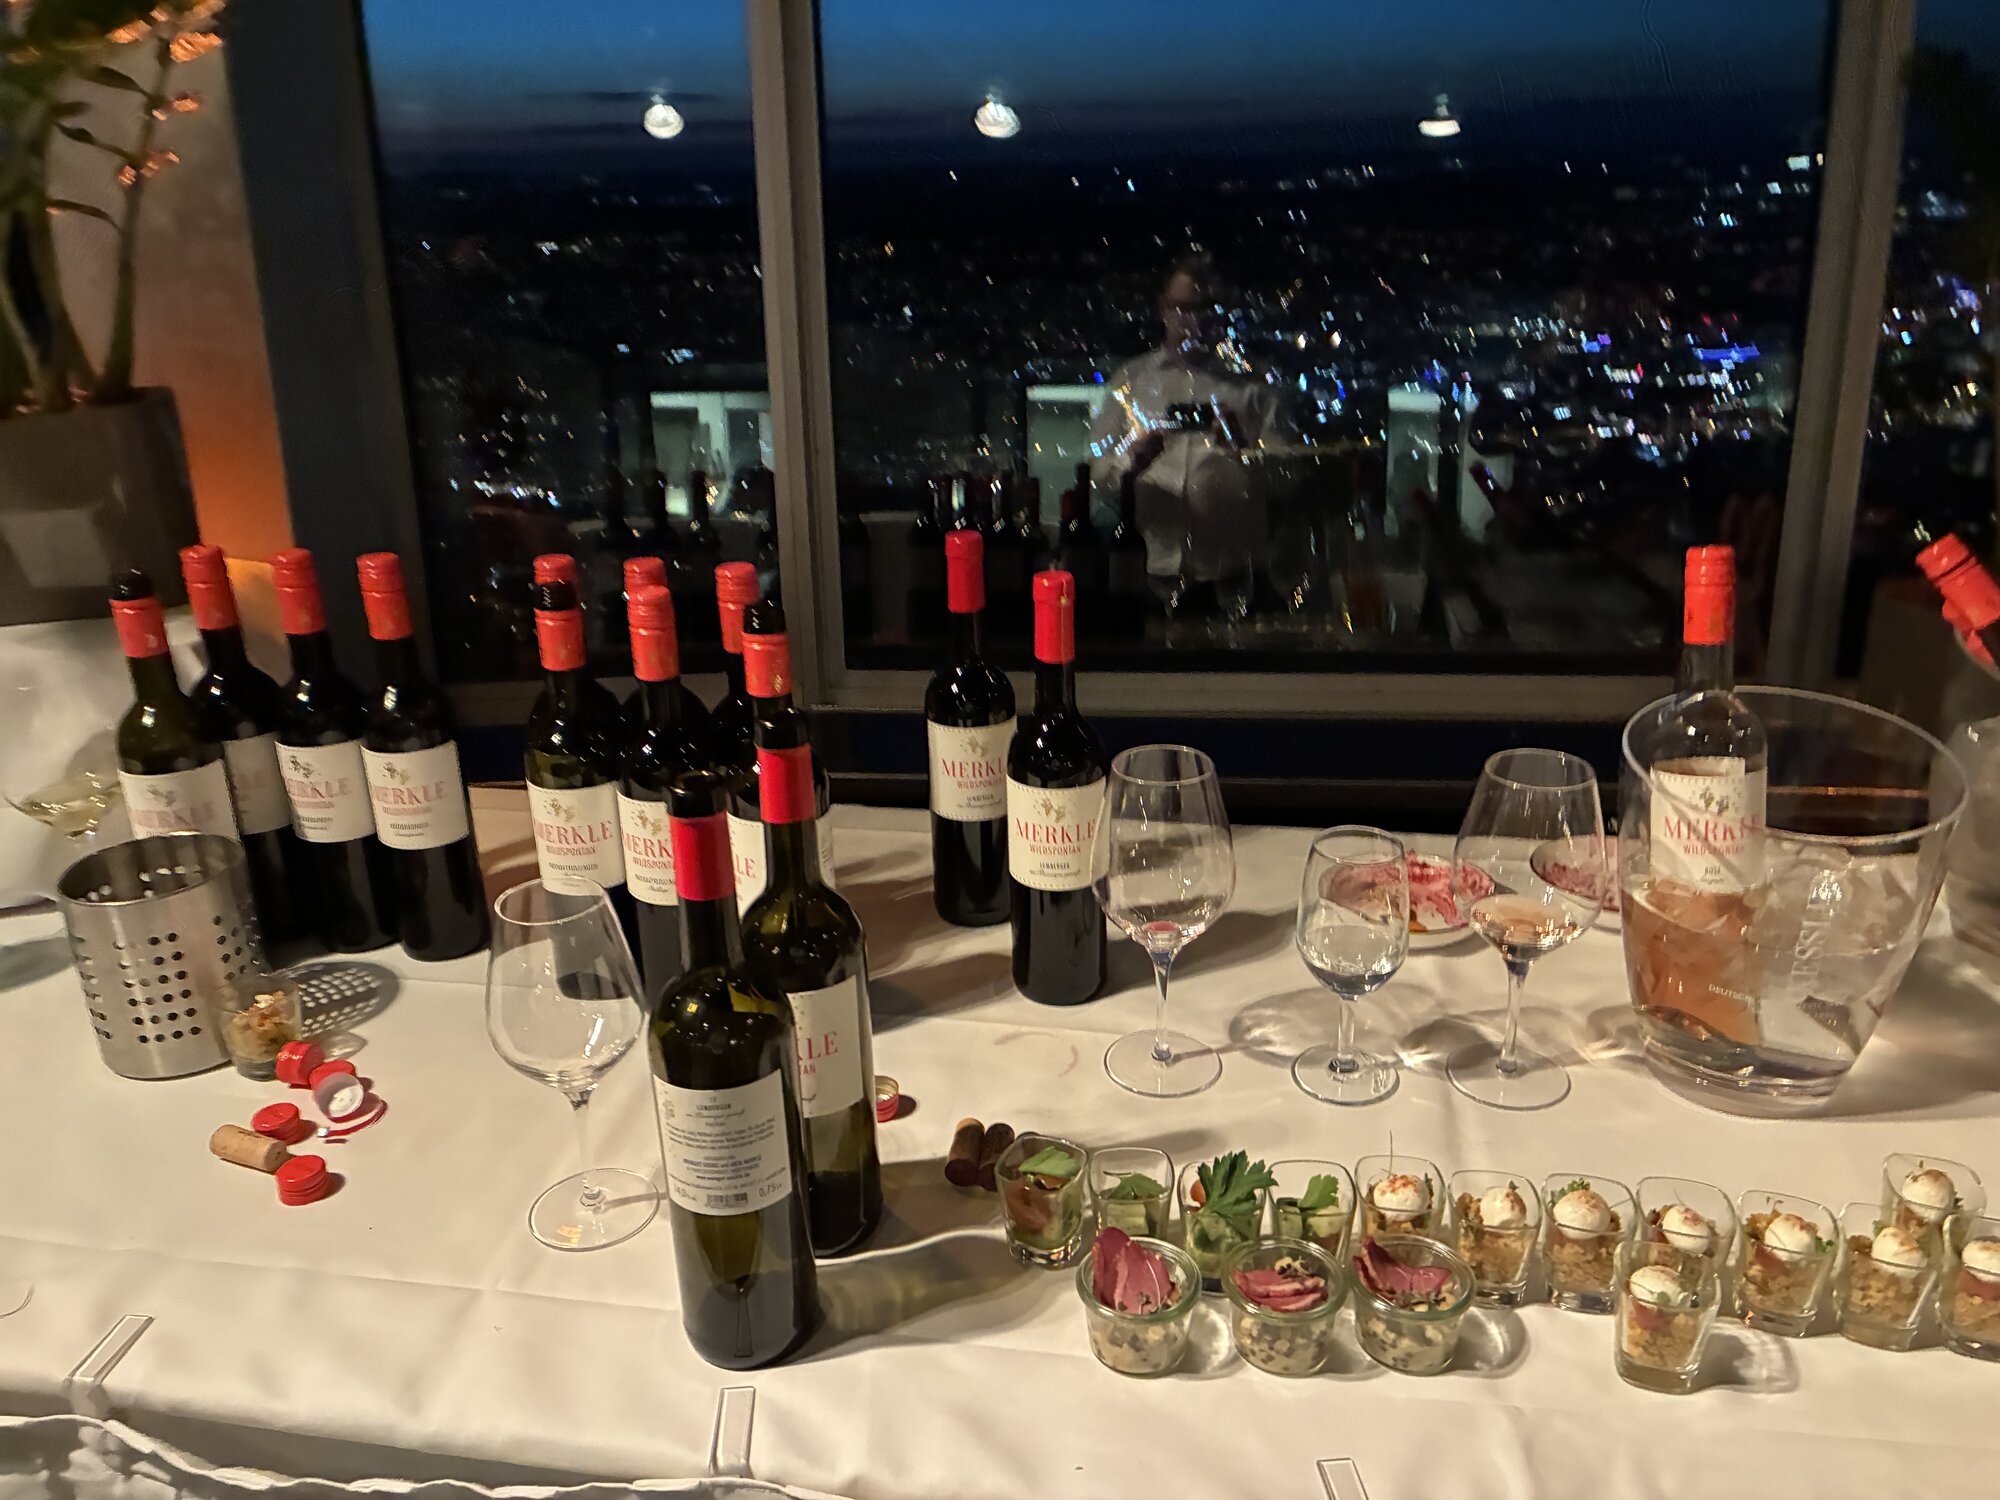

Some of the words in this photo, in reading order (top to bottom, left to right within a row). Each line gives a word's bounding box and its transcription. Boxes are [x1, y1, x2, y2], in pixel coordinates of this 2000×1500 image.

[941, 757, 1004, 779] MERKL
[622, 830, 674, 859] ERK
[1015, 817, 1097, 846] MERKLE
